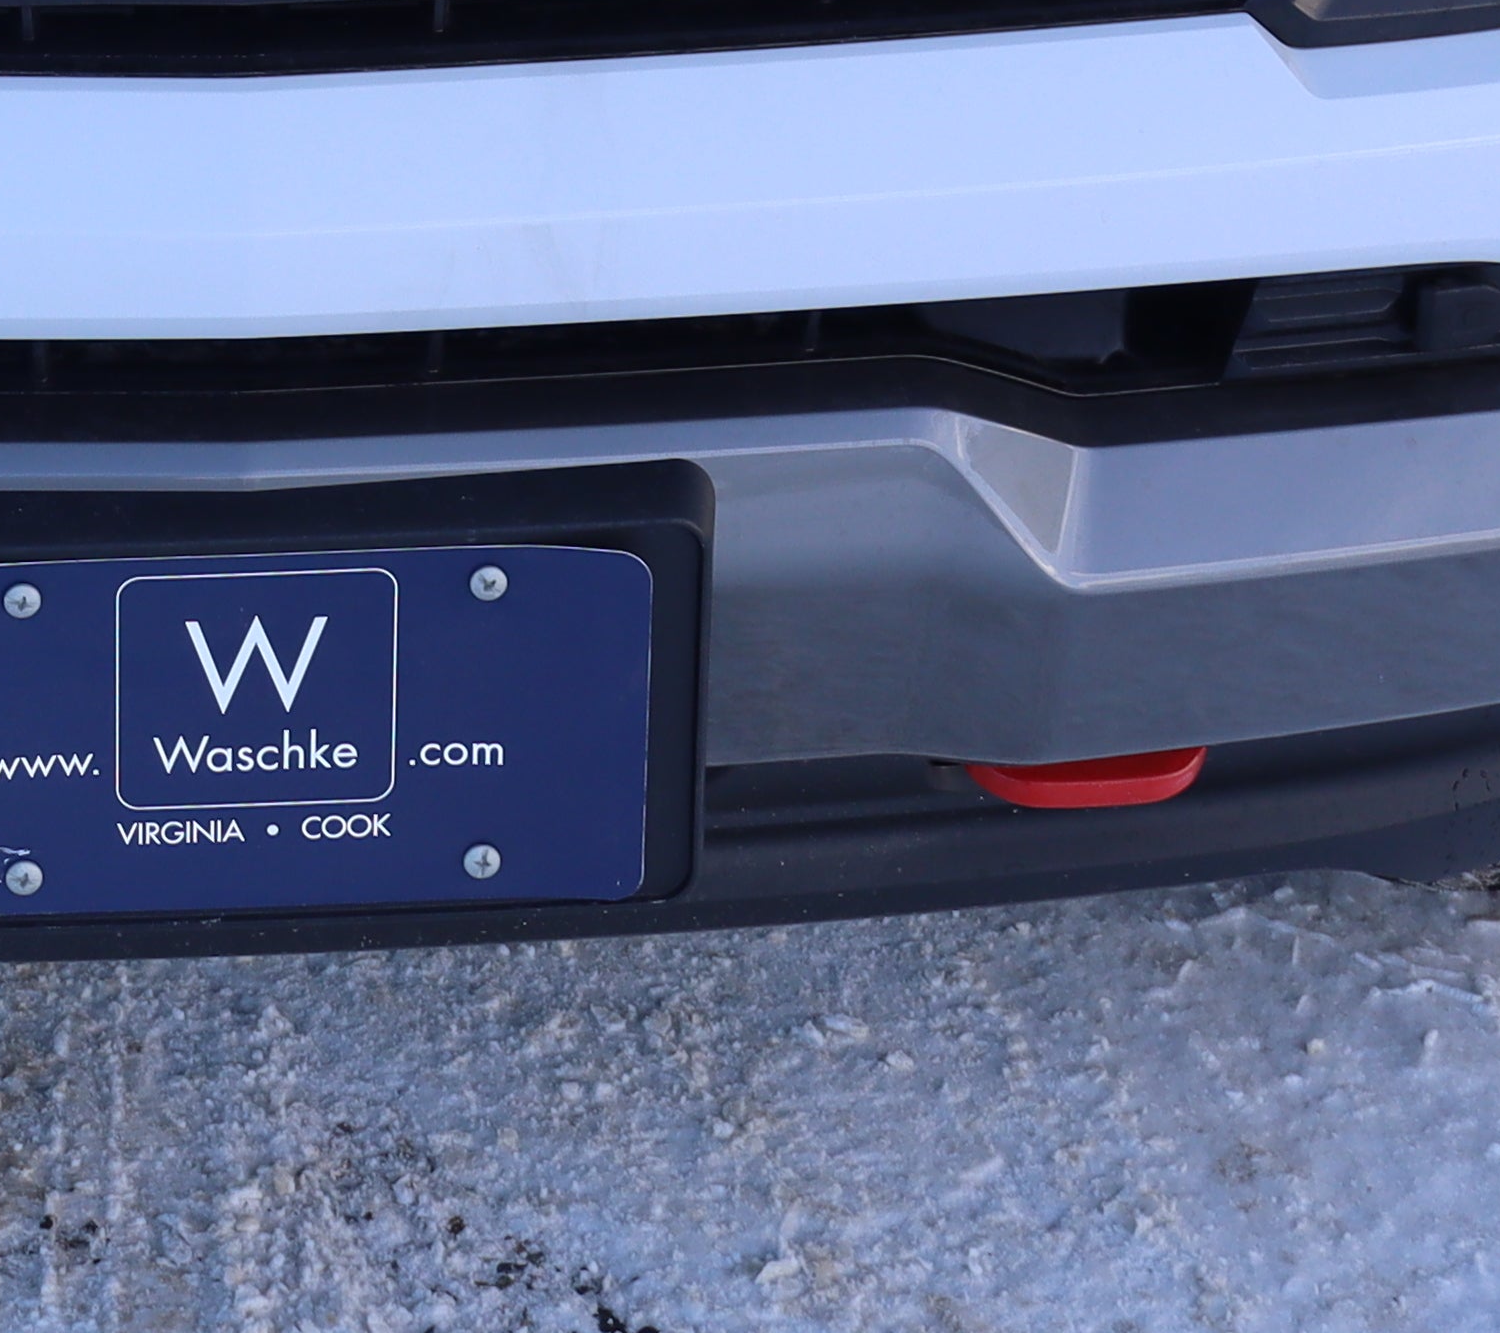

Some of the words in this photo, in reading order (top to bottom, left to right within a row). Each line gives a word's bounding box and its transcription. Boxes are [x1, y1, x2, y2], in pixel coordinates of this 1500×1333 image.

[184, 615, 329, 715] W
[152, 728, 359, 775] Waschke
[407, 735, 506, 769] .com
[116, 818, 247, 847] VIRGINIA
[300, 812, 393, 840] COOK
